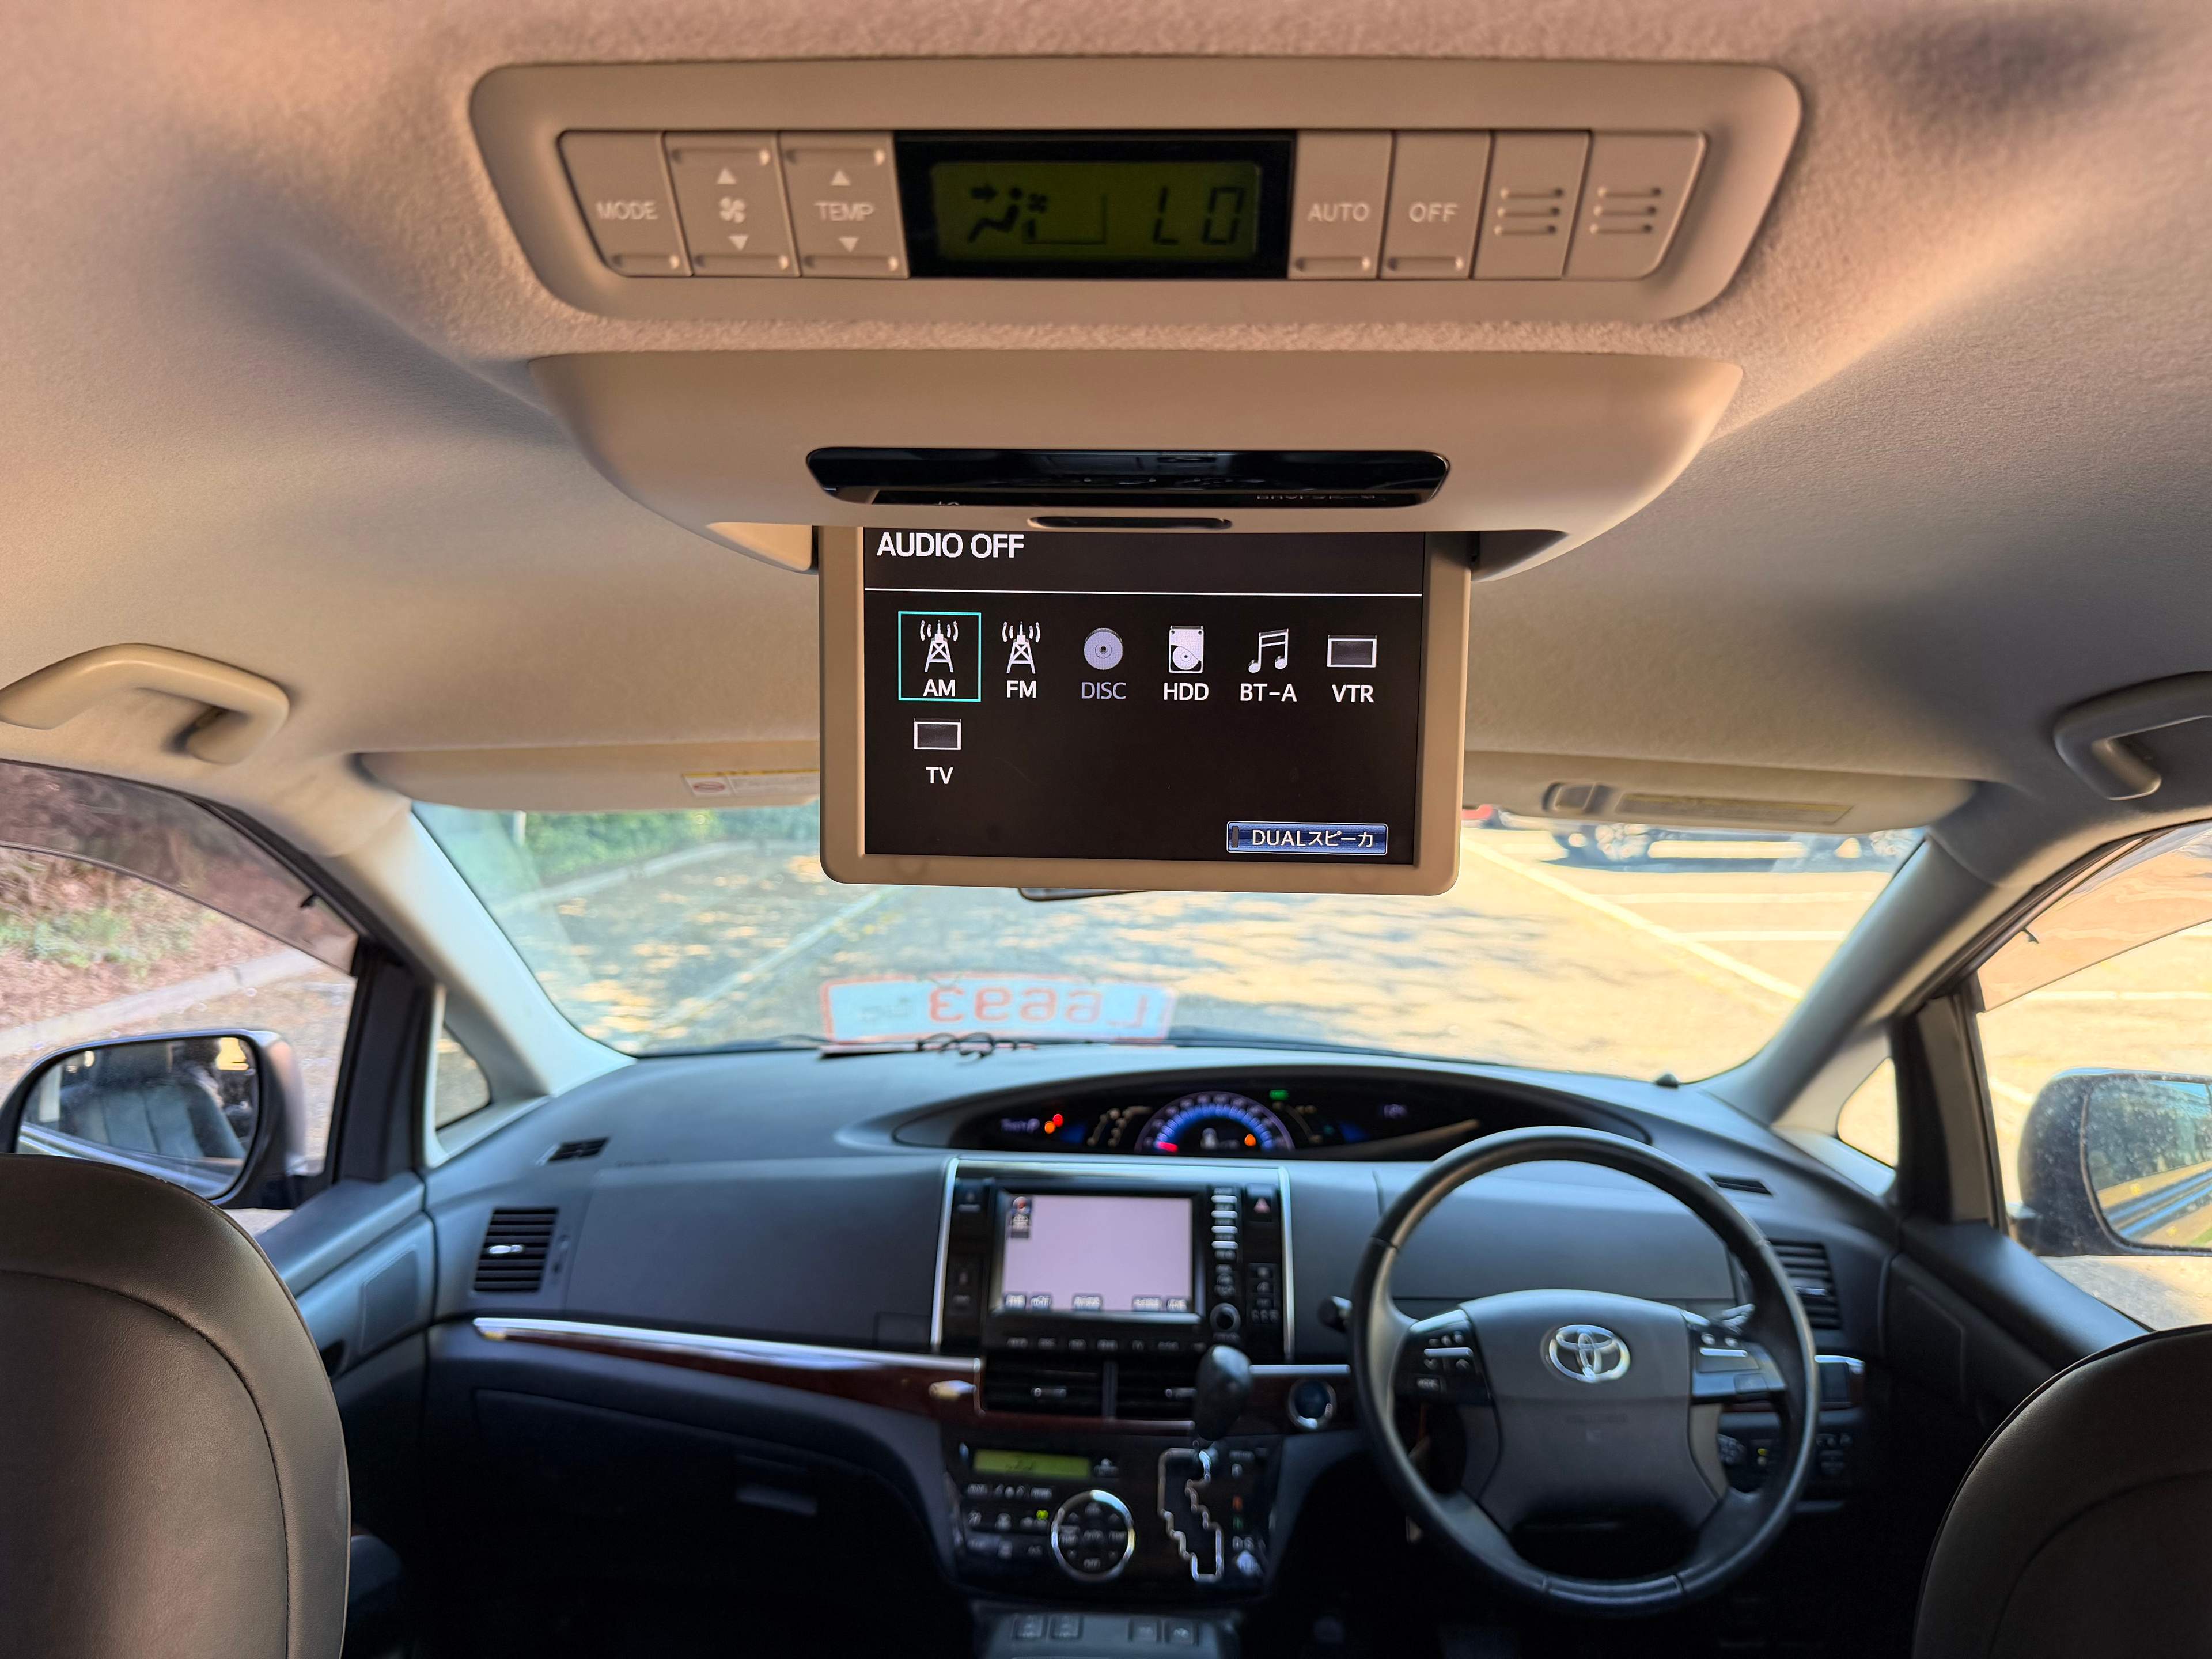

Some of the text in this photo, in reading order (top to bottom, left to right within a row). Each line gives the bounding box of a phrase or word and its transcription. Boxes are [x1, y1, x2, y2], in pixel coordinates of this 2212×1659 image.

[596, 201, 658, 221] MODE
[814, 202, 875, 222] TEMP
[1307, 202, 1370, 222] AUTO
[1408, 203, 1458, 223] OFF
[876, 532, 1024, 558] AUDIO OFF
[922, 679, 956, 697] AM
[1006, 680, 1037, 699] FM
[1081, 681, 1127, 700] DISC
[1162, 682, 1209, 702] HDD
[1240, 683, 1298, 703] BT-A
[1331, 684, 1374, 703] VTR
[925, 766, 954, 785] TV
[1252, 830, 1374, 848] DUALスピーカ
